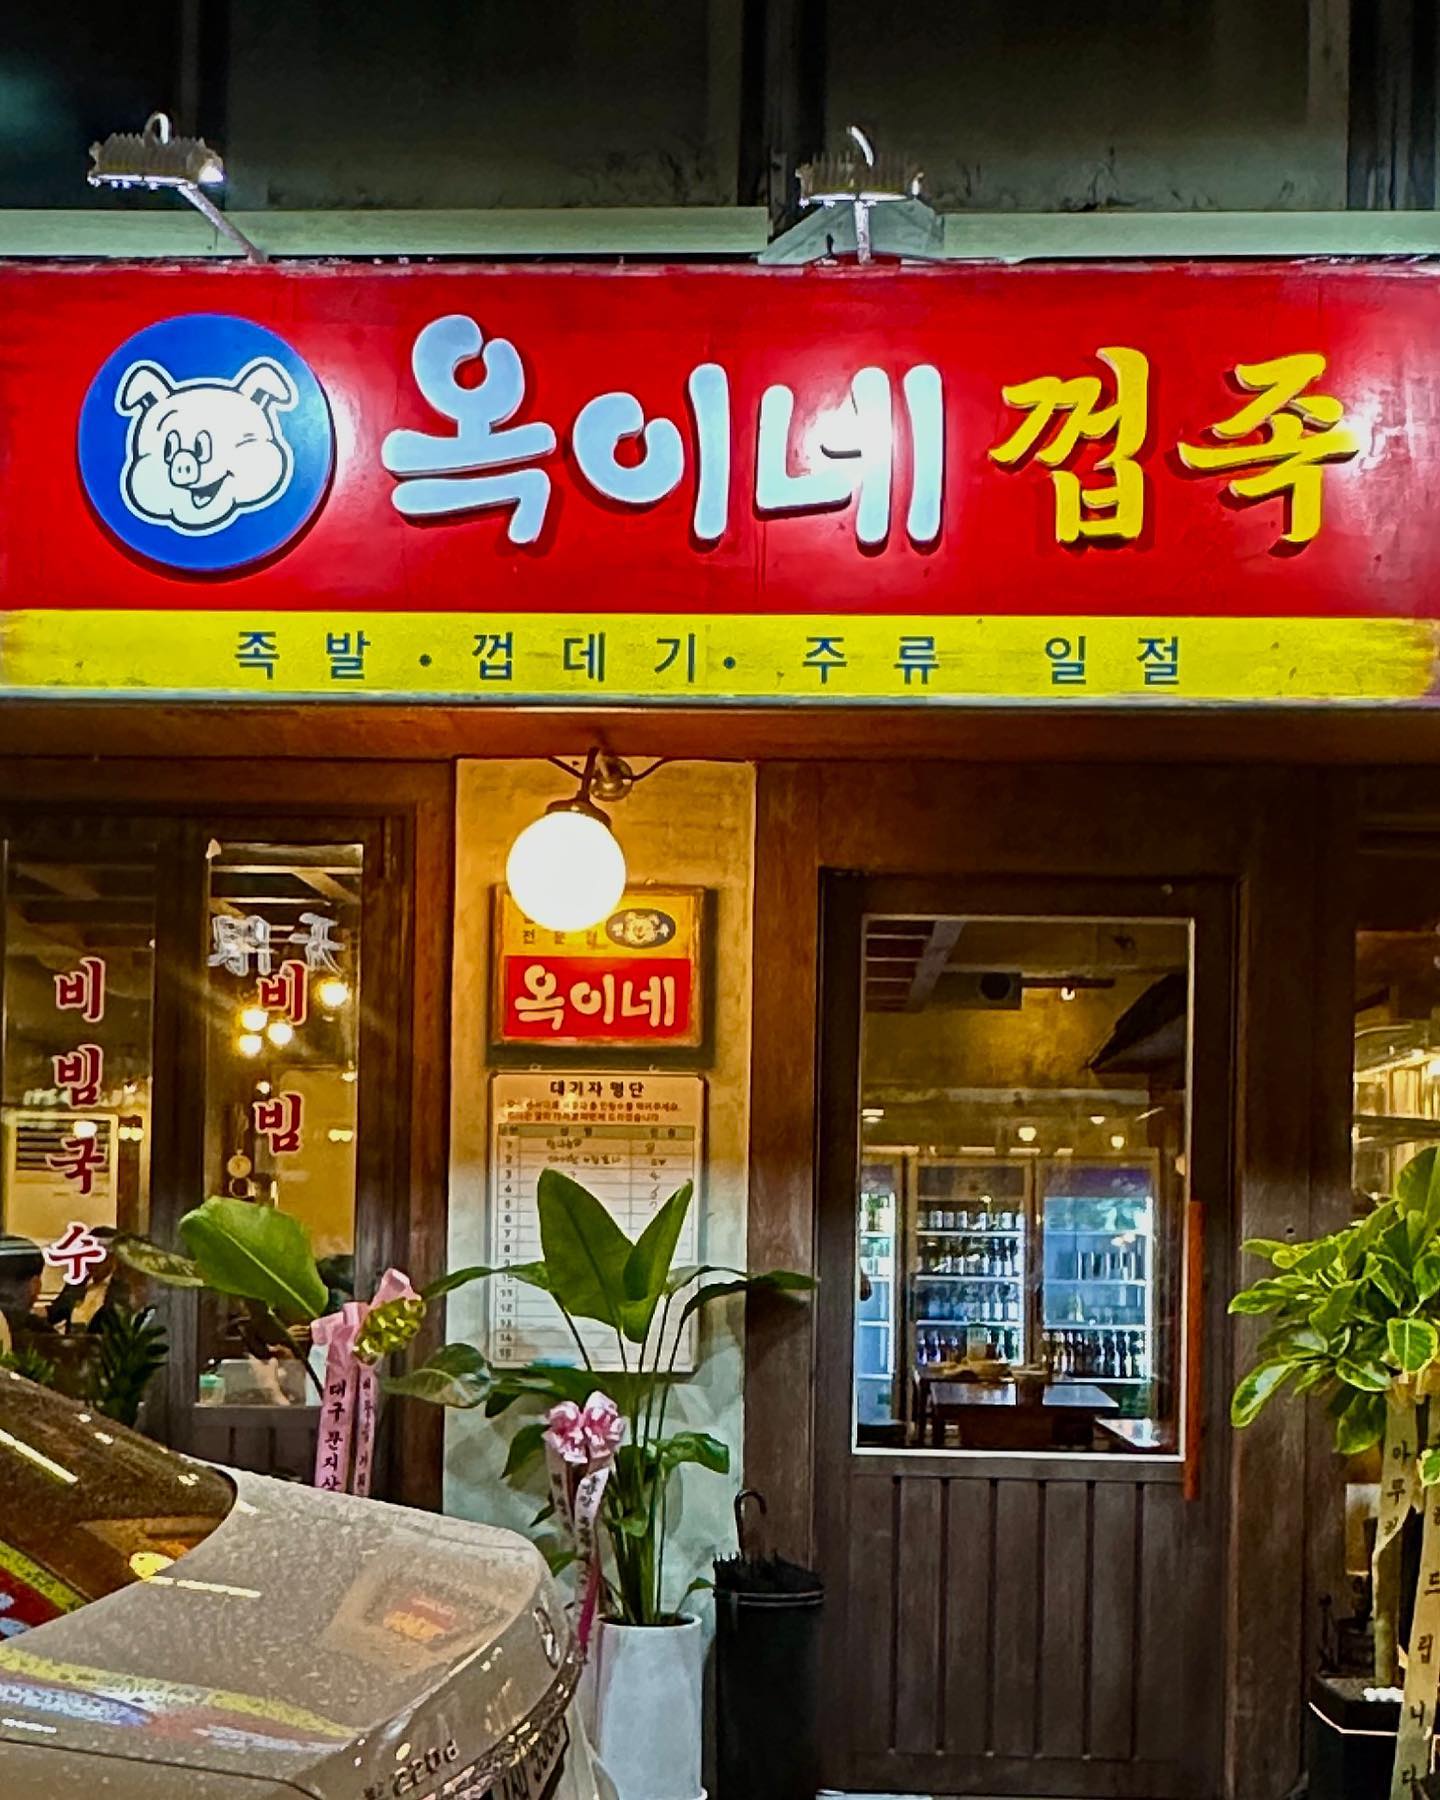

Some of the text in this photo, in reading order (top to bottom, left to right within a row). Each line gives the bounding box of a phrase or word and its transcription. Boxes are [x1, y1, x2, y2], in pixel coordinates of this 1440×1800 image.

[382, 314, 1358, 545] 옥이네 껍족
[1045, 636, 1181, 685] 일절
[514, 964, 675, 1031] 옥이네
[550, 1080, 644, 1098] 대기자 명단
[44, 957, 106, 1286] 비빔국수
[328, 1378, 347, 1424] 대구
